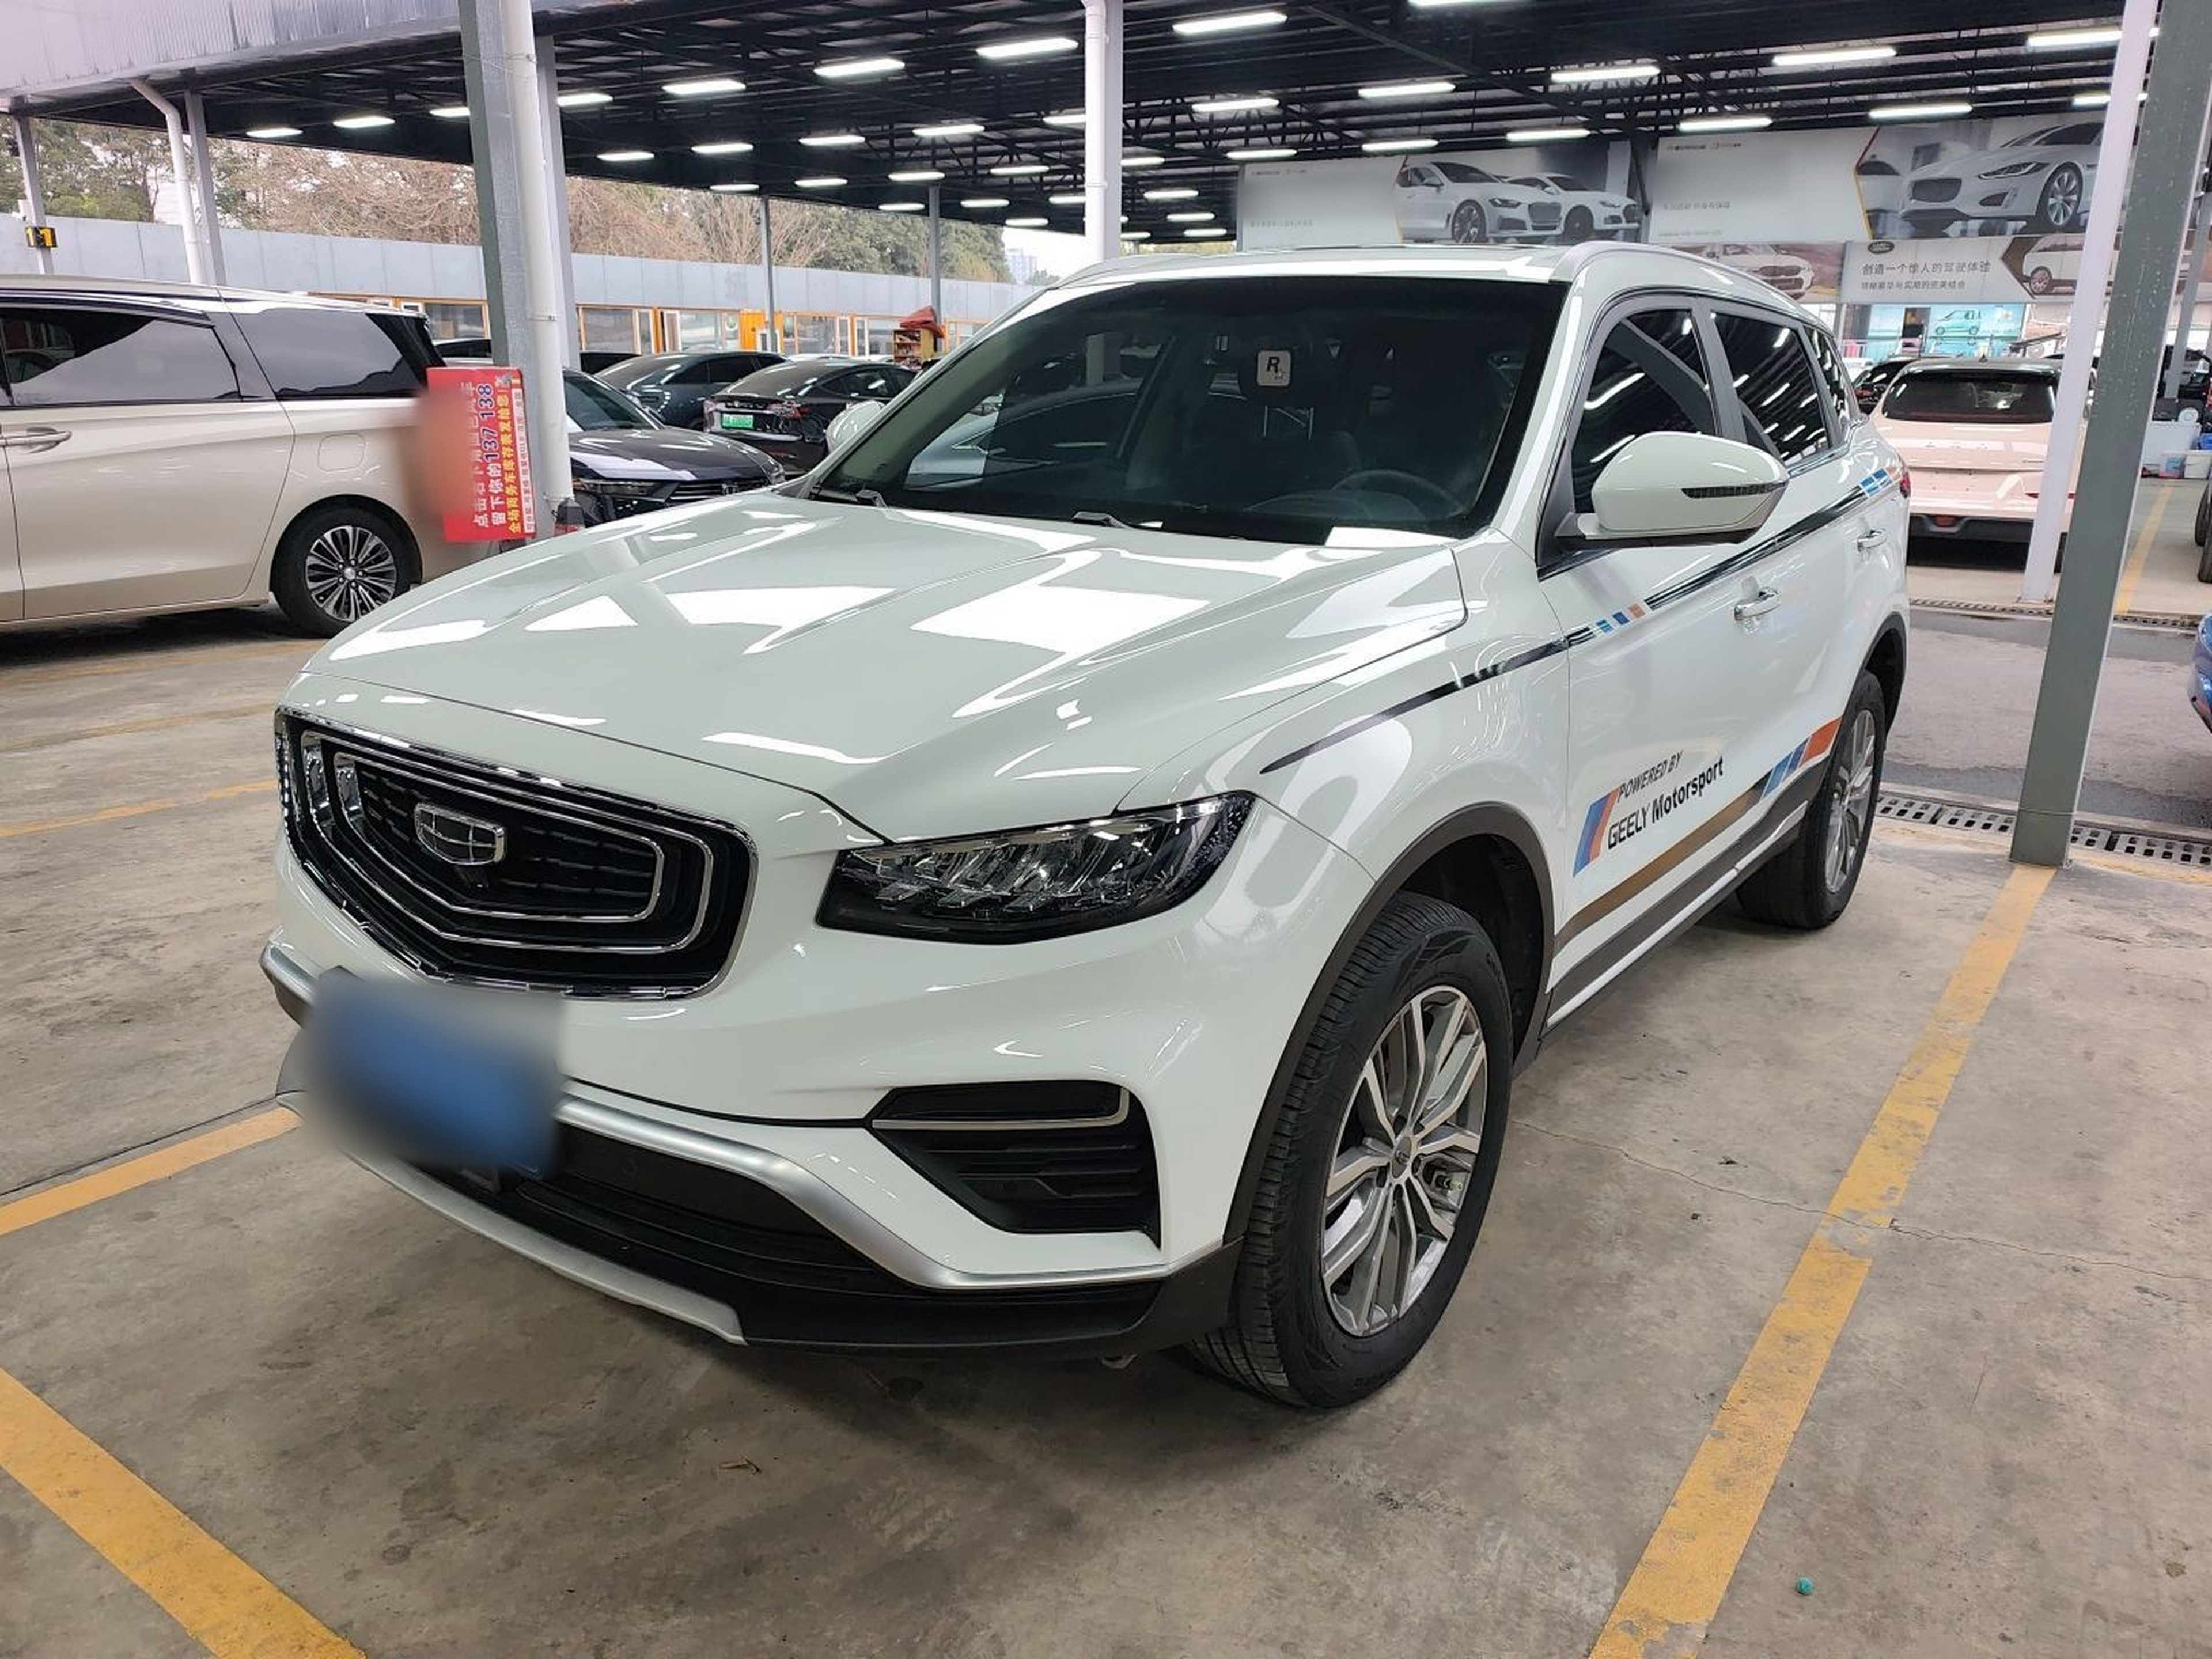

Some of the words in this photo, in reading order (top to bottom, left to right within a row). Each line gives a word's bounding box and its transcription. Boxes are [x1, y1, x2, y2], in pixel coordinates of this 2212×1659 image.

[1266, 356, 1280, 373] R
[478, 384, 495, 419] 138
[497, 394, 522, 533] 全场商务车库存表发给您
[1616, 763, 1668, 802] POWERED
[1666, 750, 1684, 772] BY
[1608, 804, 1650, 850] GEELY
[1652, 755, 1724, 825] Motorsport
